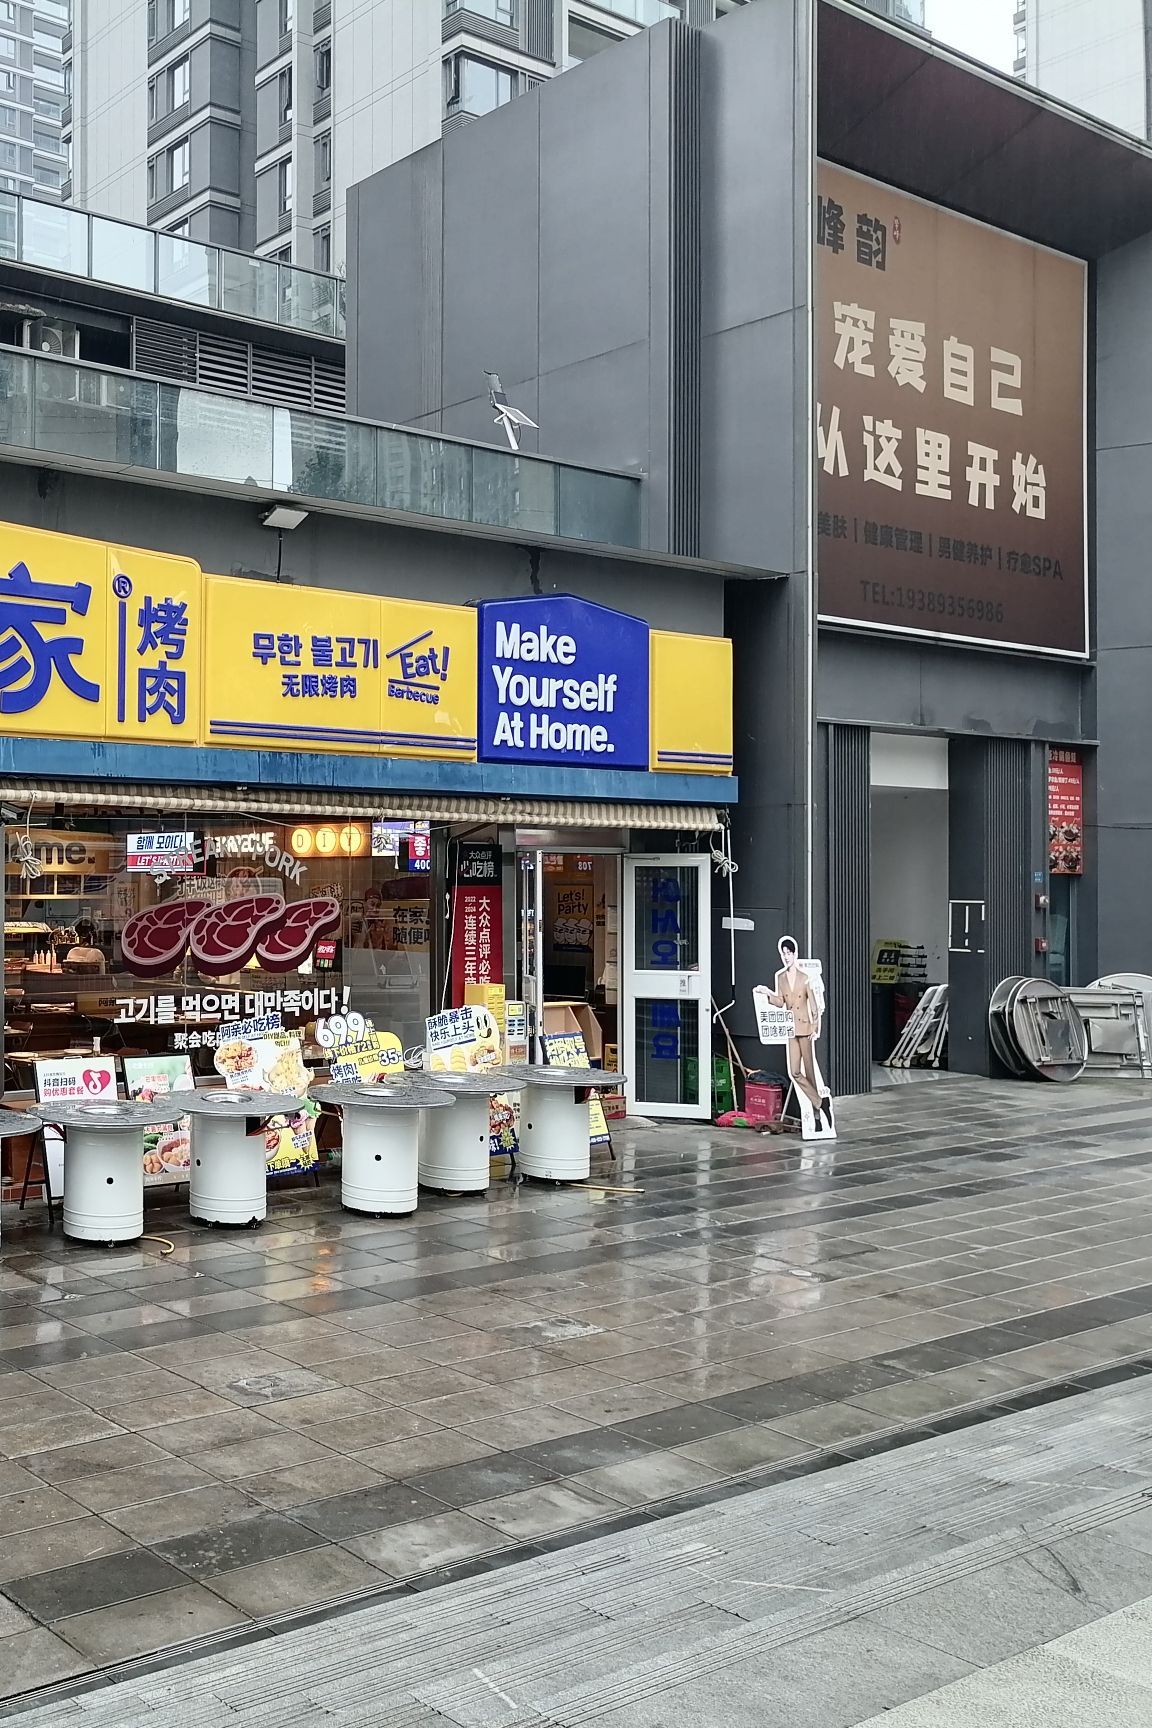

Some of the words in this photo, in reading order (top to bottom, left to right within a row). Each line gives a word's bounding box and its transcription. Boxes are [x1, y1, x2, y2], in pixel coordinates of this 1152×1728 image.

[833, 301, 1023, 416] 宠爱自己
[817, 402, 1046, 520] 从这里开始
[252, 632, 303, 669] 무한
[311, 635, 379, 669] 불고기
[495, 621, 576, 665] Make
[137, 595, 189, 724] 烤肉
[400, 646, 450, 681] Eat!
[281, 674, 357, 699] 无限烤肉
[388, 684, 440, 705] Barbecue
[492, 665, 617, 713] Yourself
[493, 712, 524, 748] At
[530, 714, 615, 753] Home.
[557, 902, 589, 916] Party
[113, 994, 177, 1025] 고기를
[181, 993, 240, 1022] 먹으면
[427, 1007, 473, 1030] 酥脆暴击
[760, 1010, 793, 1023] 美团团购
[220, 1013, 281, 1039] 阿亲必吃榜
[315, 1011, 366, 1048] 69.9
[429, 1020, 475, 1042] 快乐上头
[761, 1025, 794, 1038] 团啥都省
[43, 1076, 76, 1088] 抖音扫码
[331, 1063, 359, 1078] 烤肉!
